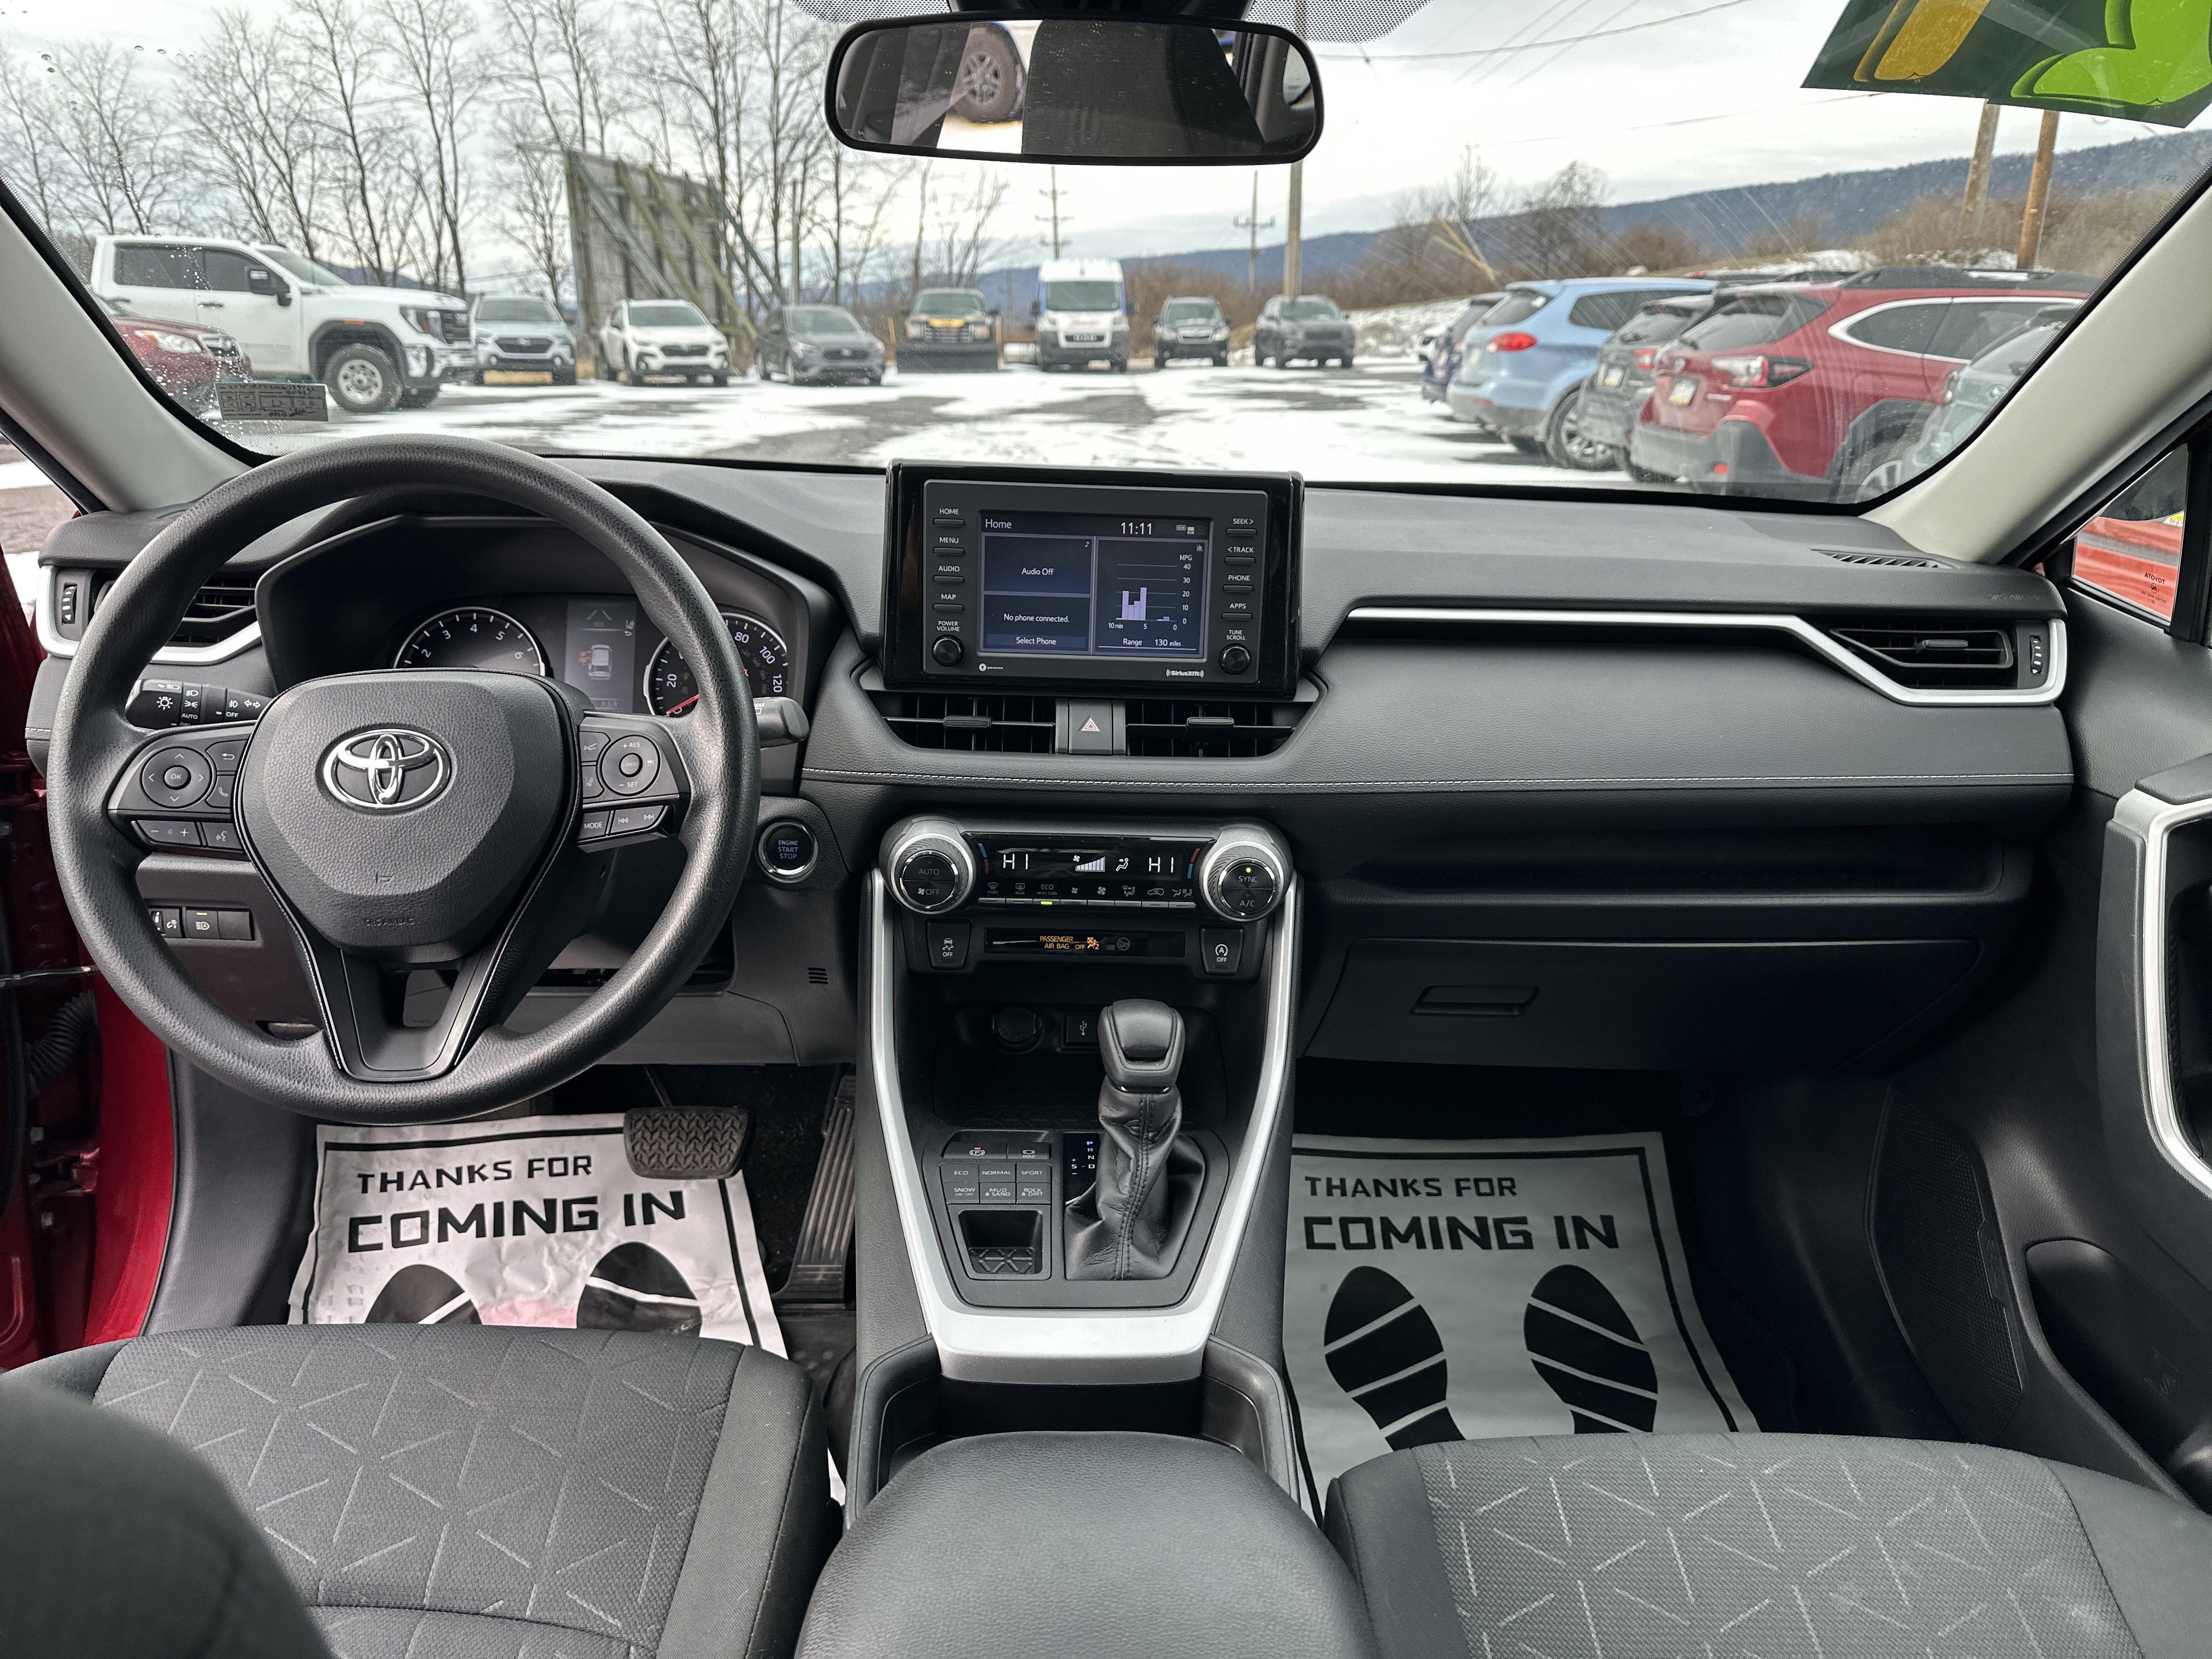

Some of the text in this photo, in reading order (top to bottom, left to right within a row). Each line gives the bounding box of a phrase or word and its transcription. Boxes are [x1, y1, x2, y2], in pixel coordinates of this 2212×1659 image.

[985, 518, 1012, 529] Home
[1121, 522, 1152, 535] 11:11
[1021, 567, 1040, 575] Audio
[1015, 614, 1034, 623] phone
[470, 624, 478, 633] 4
[442, 630, 451, 640] 3
[495, 631, 506, 641] 5
[735, 631, 749, 644] 80
[1015, 636, 1035, 645] Select
[1122, 638, 1142, 646] Range
[421, 649, 431, 658] 2
[759, 646, 775, 664] 100
[667, 674, 677, 688] 20
[772, 674, 783, 693] 120
[584, 821, 602, 830] MODE
[358, 1155, 592, 1194] THANKS FOR
[1304, 1176, 1517, 1198] THANKS FOR
[347, 1190, 686, 1253] COMING IN
[1304, 1215, 1619, 1250] COMING IN
